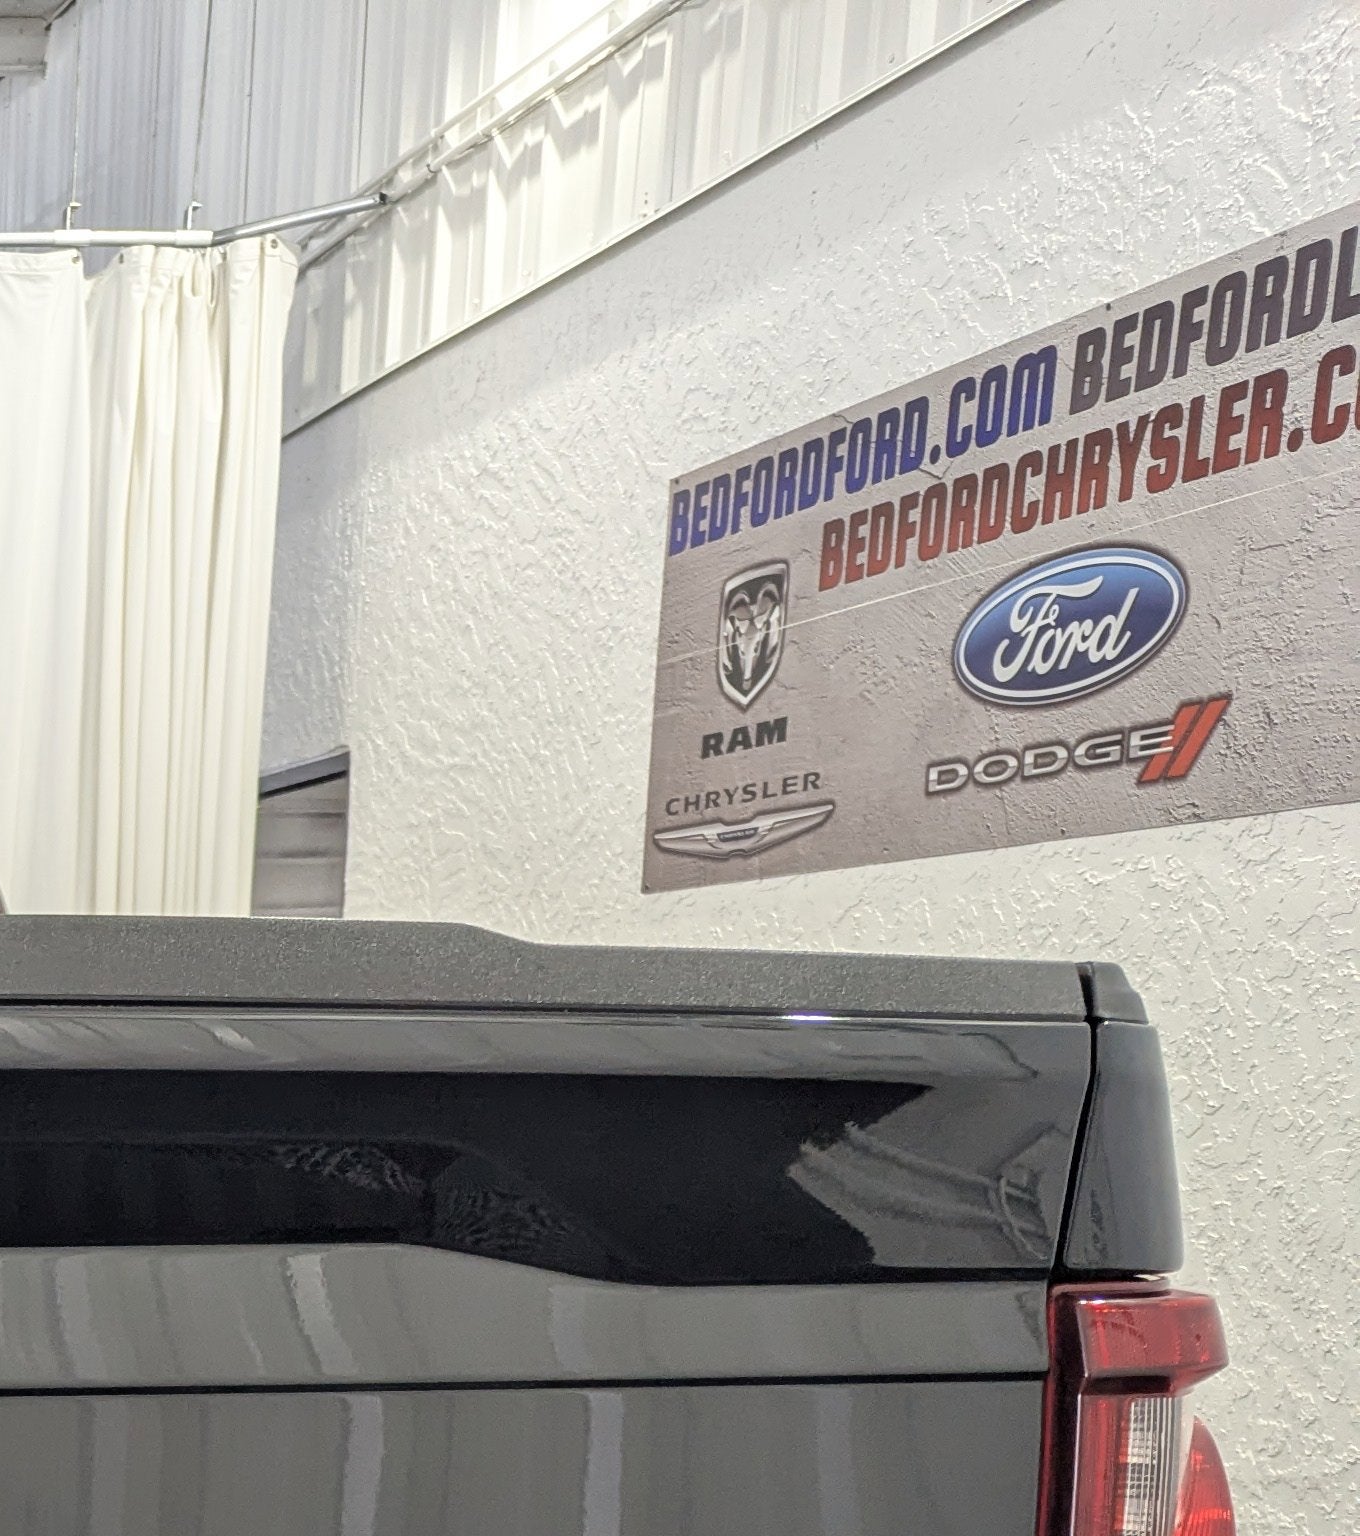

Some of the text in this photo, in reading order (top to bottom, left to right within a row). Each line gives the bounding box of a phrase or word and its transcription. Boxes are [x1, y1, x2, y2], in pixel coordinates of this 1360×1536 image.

[668, 344, 1058, 557] BEDFORDFORD.COM
[818, 344, 1360, 592] BEDFORDCHRYSLER.C
[991, 575, 1139, 683] Ford
[701, 716, 788, 760] RAM
[924, 728, 1176, 795] DODGE
[665, 772, 821, 815] CHRYSLER
